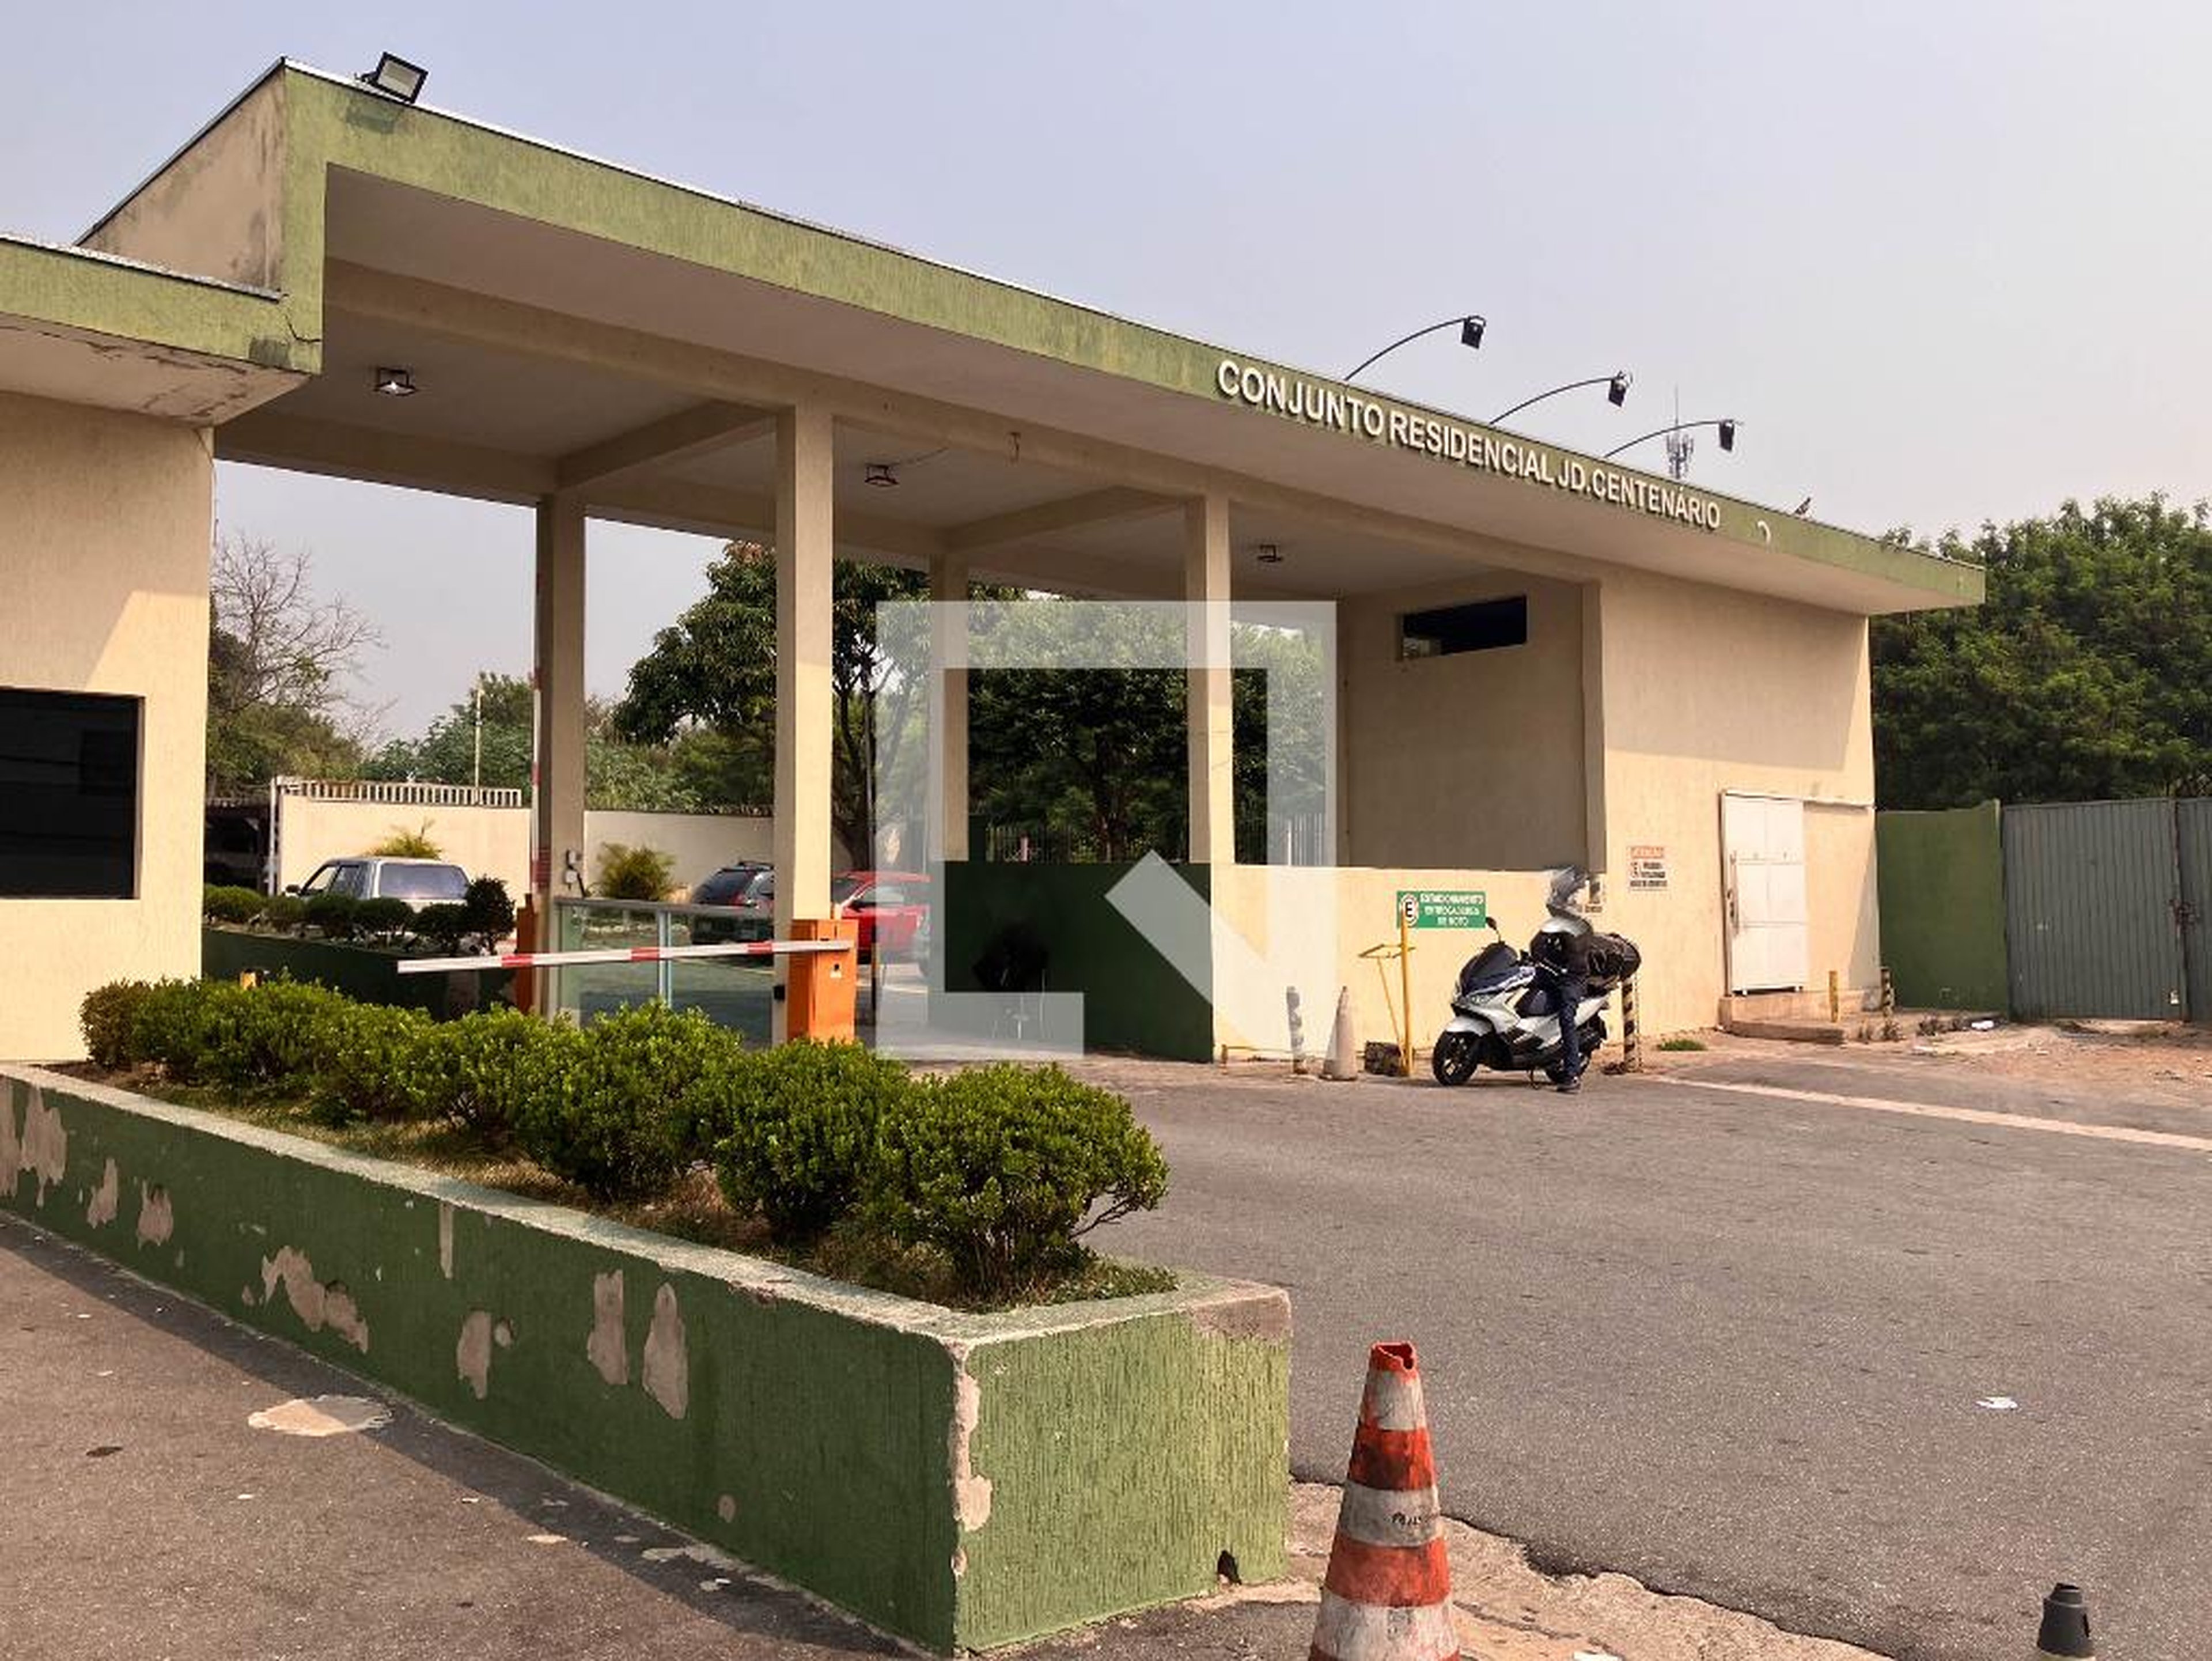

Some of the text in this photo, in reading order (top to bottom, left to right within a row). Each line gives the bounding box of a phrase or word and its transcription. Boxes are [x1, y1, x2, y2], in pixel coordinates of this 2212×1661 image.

[1218, 360, 1384, 437] CONJUNTO
[1389, 410, 1555, 483] RESIDENCIAL
[1405, 901, 1413, 918] E
